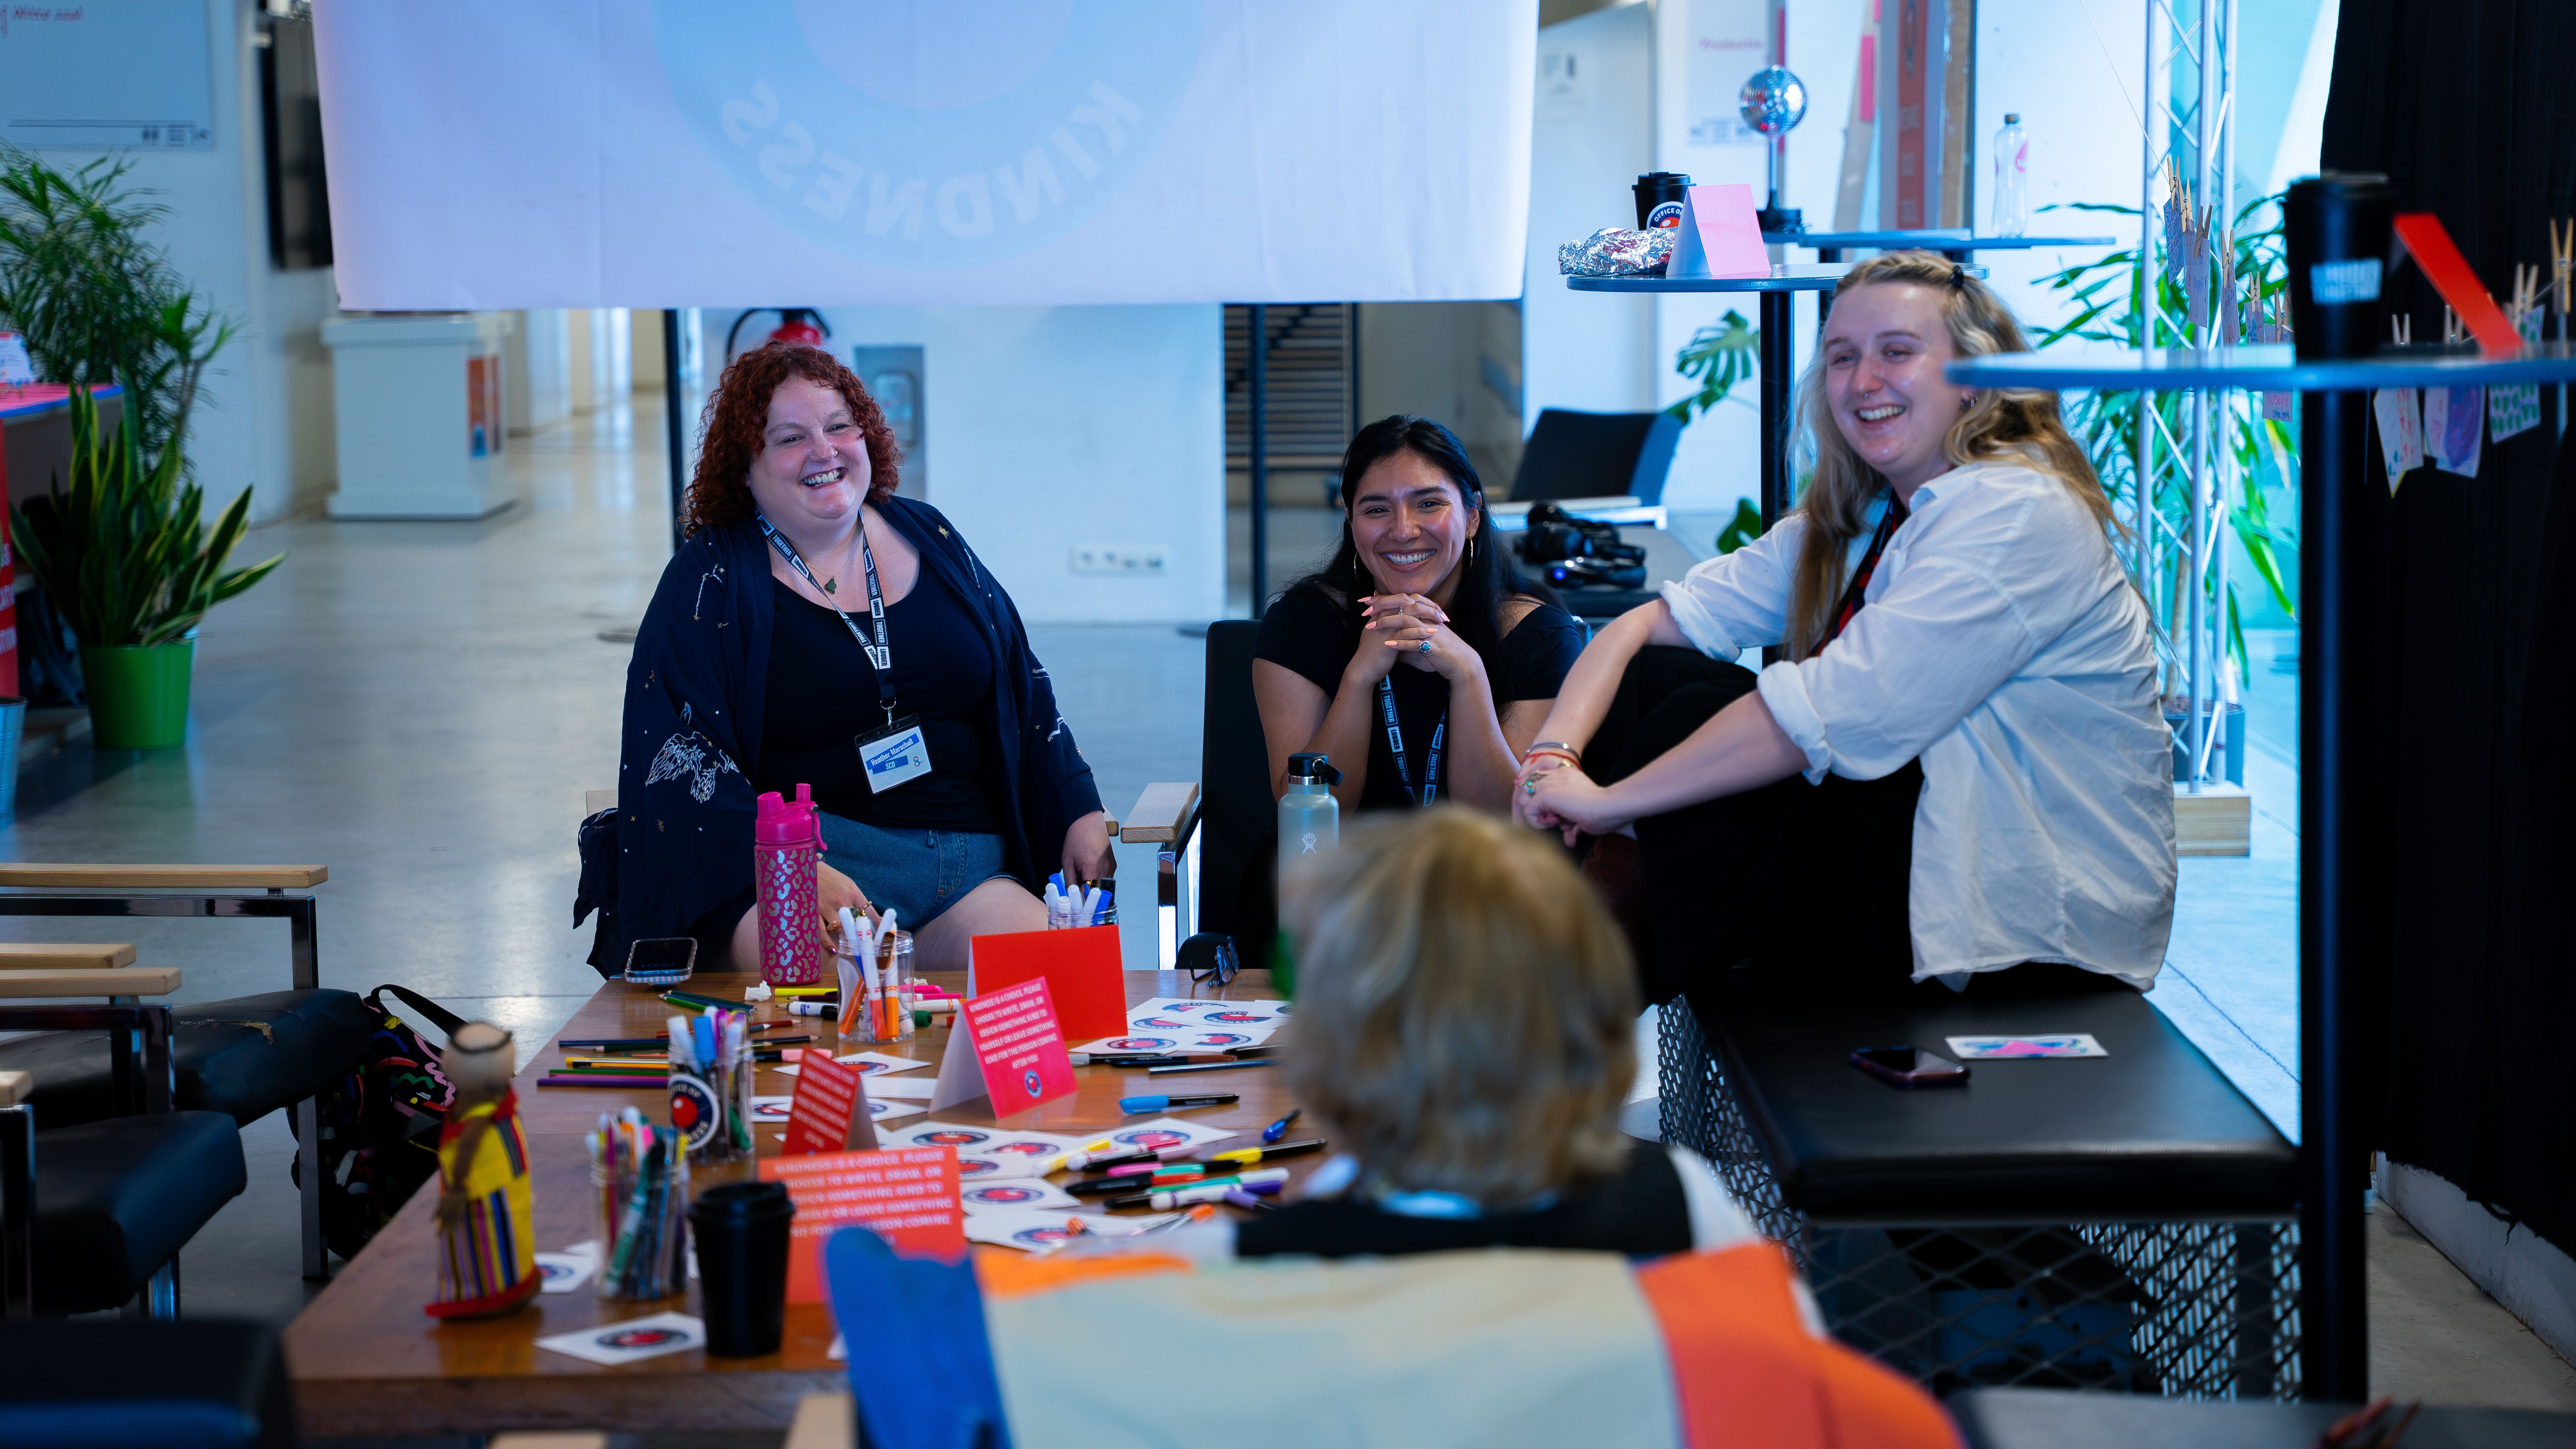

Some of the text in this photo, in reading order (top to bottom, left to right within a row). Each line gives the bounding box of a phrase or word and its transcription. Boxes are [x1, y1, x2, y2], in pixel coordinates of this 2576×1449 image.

[1654, 208, 1675, 222] OFFICE
[772, 534, 792, 557] TOGETHER
[794, 558, 807, 576] LOUDER
[869, 573, 878, 597] TOGETHER
[848, 621, 867, 643] TOGETHER
[876, 621, 885, 643] TOGETHER
[1384, 694, 1394, 723] TOGETHER
[1390, 729, 1400, 750] LOUDER
[871, 738, 914, 766] Heather Marschall
[885, 761, 896, 770] SCO
[1396, 756, 1408, 782] TOGETHER
[1429, 754, 1437, 780] TOGETHER
[969, 999, 994, 1012] KINDNESS
[994, 996, 1000, 1004] IS
[1023, 983, 1042, 995] PLEASE
[974, 1012, 995, 1025] CHOOSE
[995, 1009, 1002, 1019] TO
[1036, 996, 1044, 1005] OR
[979, 1009, 1048, 1038] DESIGN SOMETHING KIND TO
[979, 1020, 1055, 1052] YOURSELF OR LEAVE SOMETHING
[984, 1034, 1058, 1064] KIND FOR THE PERSON COMING
[1012, 1058, 1028, 1069] AFTER
[827, 1173, 842, 1186] TO
[924, 1164, 943, 1178] OR
[827, 1185, 893, 1201] SOMETHING
[926, 1181, 943, 1193] TO
[885, 1196, 953, 1213] SOMETHING
